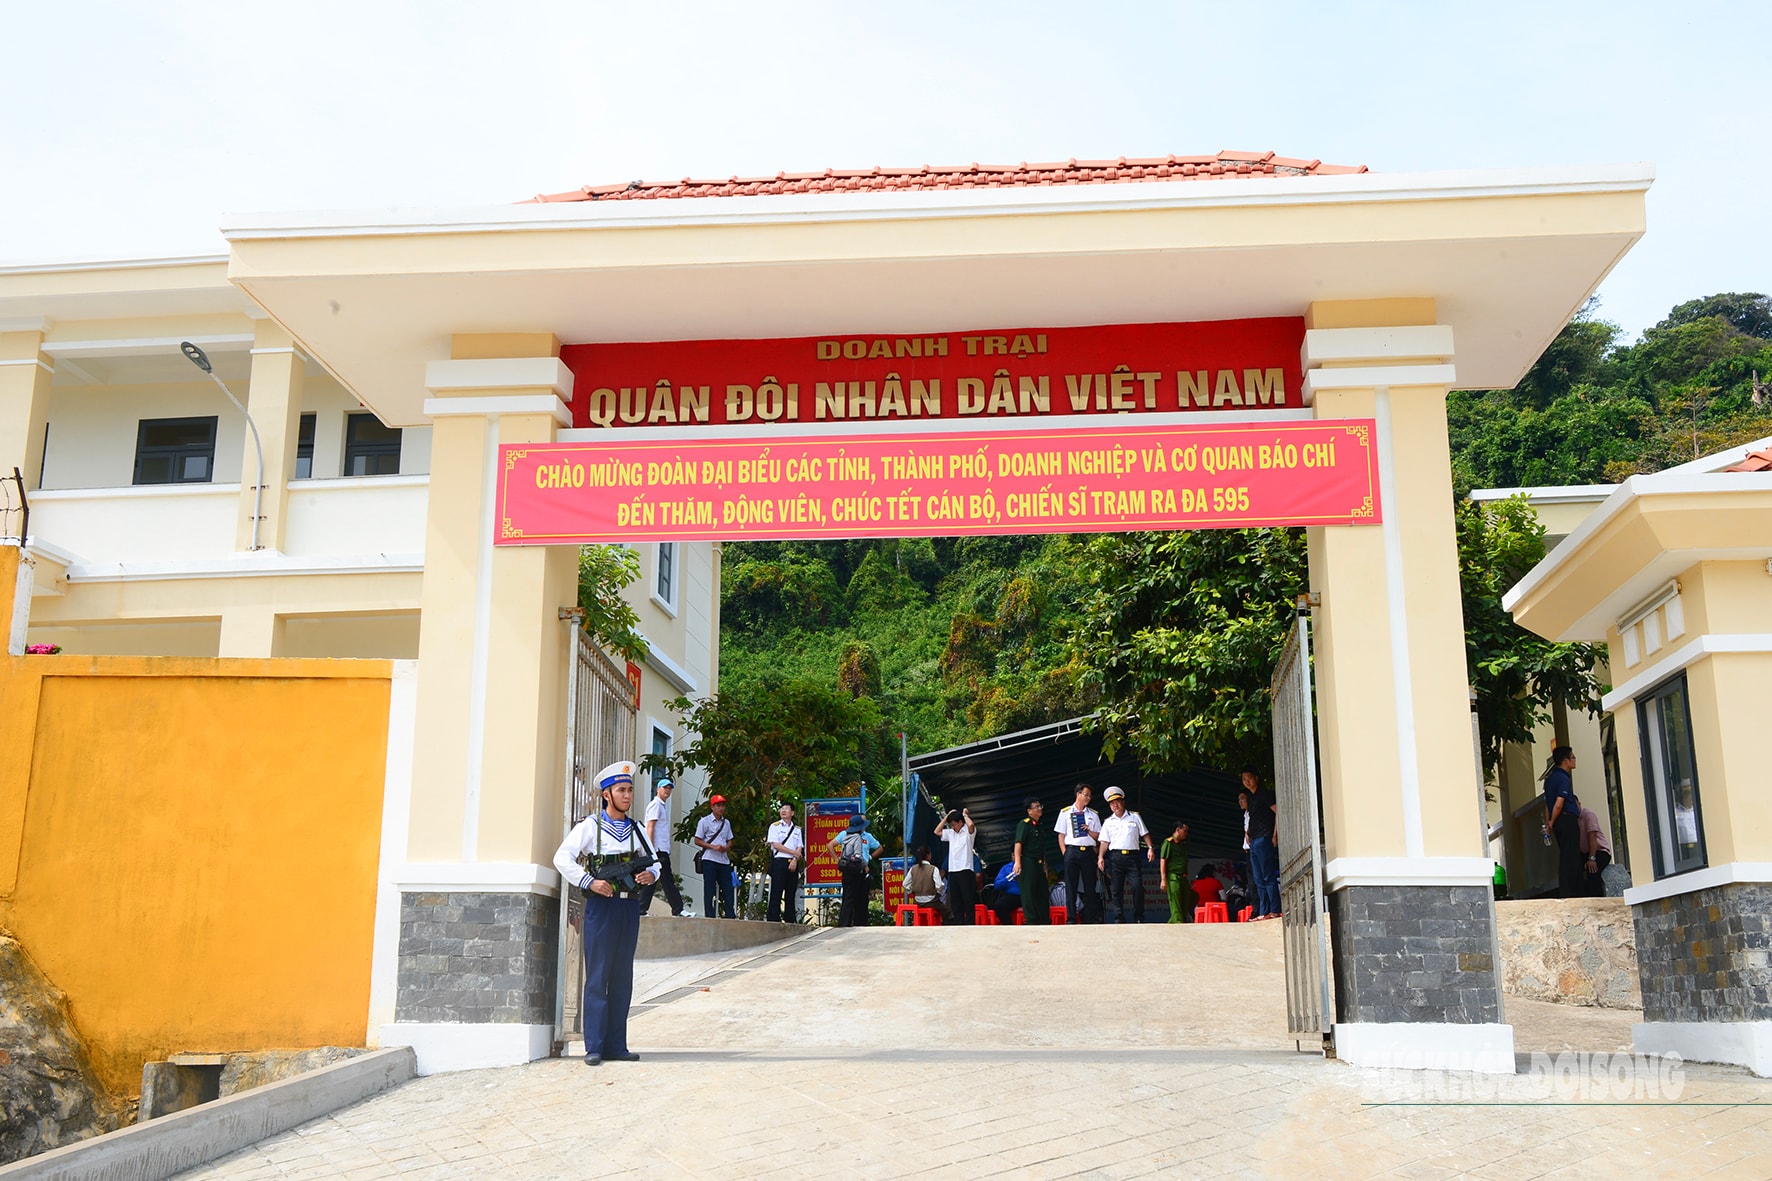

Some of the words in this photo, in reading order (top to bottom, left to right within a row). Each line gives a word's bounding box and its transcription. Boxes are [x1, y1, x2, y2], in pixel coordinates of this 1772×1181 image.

[817, 337, 948, 360] DOANH
[961, 334, 1048, 358] TRẠI
[589, 379, 710, 428] QUÂN
[724, 375, 798, 424] ĐỘI
[815, 372, 941, 420] NHÂN
[957, 369, 1050, 415] DÂN
[1065, 364, 1161, 414] VIỆT
[1177, 368, 1286, 408] NAM
[536, 458, 585, 488] CHÀO
[590, 457, 643, 487] MỪNG
[647, 455, 697, 486] ĐOÀN
[702, 460, 732, 489] ĐẠI
[738, 447, 781, 484] BIỂU
[786, 452, 822, 482] CÁC
[827, 448, 876, 485] TỈNH,
[881, 449, 943, 480] THÀNH
[950, 444, 993, 482] PHỐ,
[998, 451, 1062, 478] DOANH
[1068, 443, 1137, 479] NGHIỆP
[1141, 442, 1167, 473] VÀ
[1171, 444, 1197, 472] CƠ
[1202, 446, 1253, 475] QUAN
[1259, 437, 1298, 469] BÁO
[1302, 436, 1336, 467] CHÍ
[617, 493, 655, 527] ĐẾN
[659, 497, 718, 529] THĂM,
[723, 494, 773, 529] ĐỘNG
[778, 492, 827, 526] VIÊN,
[831, 490, 882, 521] CHÚC
[886, 487, 921, 521] TẾT
[927, 489, 964, 520] CÁN
[970, 488, 1001, 524] BỘ,
[1006, 483, 1063, 519] CHIẾN
[1068, 485, 1087, 516] SĨ
[1091, 488, 1146, 520] TRẠM
[1151, 488, 1177, 514] RA
[1181, 487, 1208, 513] ĐA
[1213, 486, 1250, 512] 595
